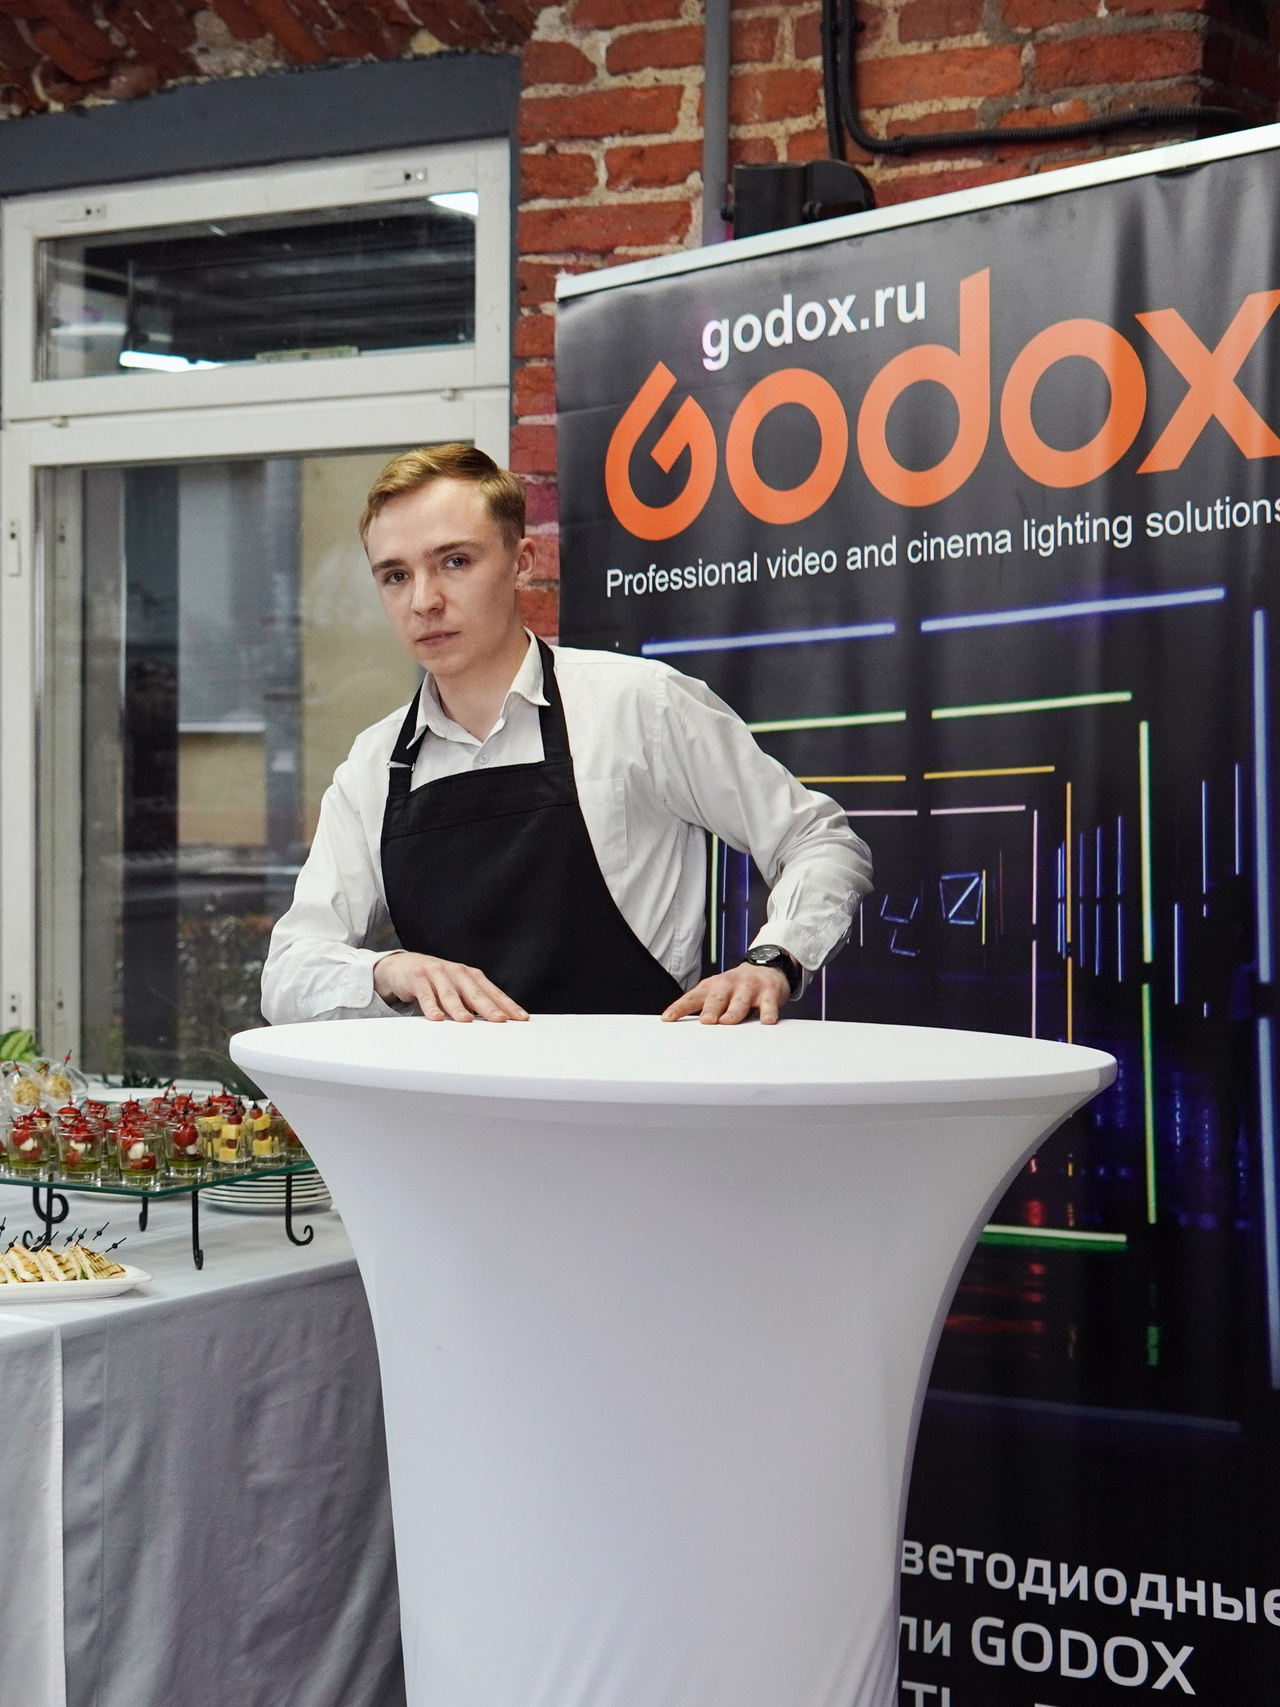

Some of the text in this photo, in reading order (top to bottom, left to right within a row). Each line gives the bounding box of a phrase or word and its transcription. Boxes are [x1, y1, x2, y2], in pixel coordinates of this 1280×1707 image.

[701, 281, 927, 370] godox.ru
[606, 551, 759, 598] Professional
[766, 547, 838, 580] video
[846, 534, 898, 571] and
[907, 529, 1012, 565] cinema
[1023, 511, 1132, 556] lighting
[901, 1540, 1280, 1627] ветодиодные
[900, 1615, 1197, 1695] ли GODOX
